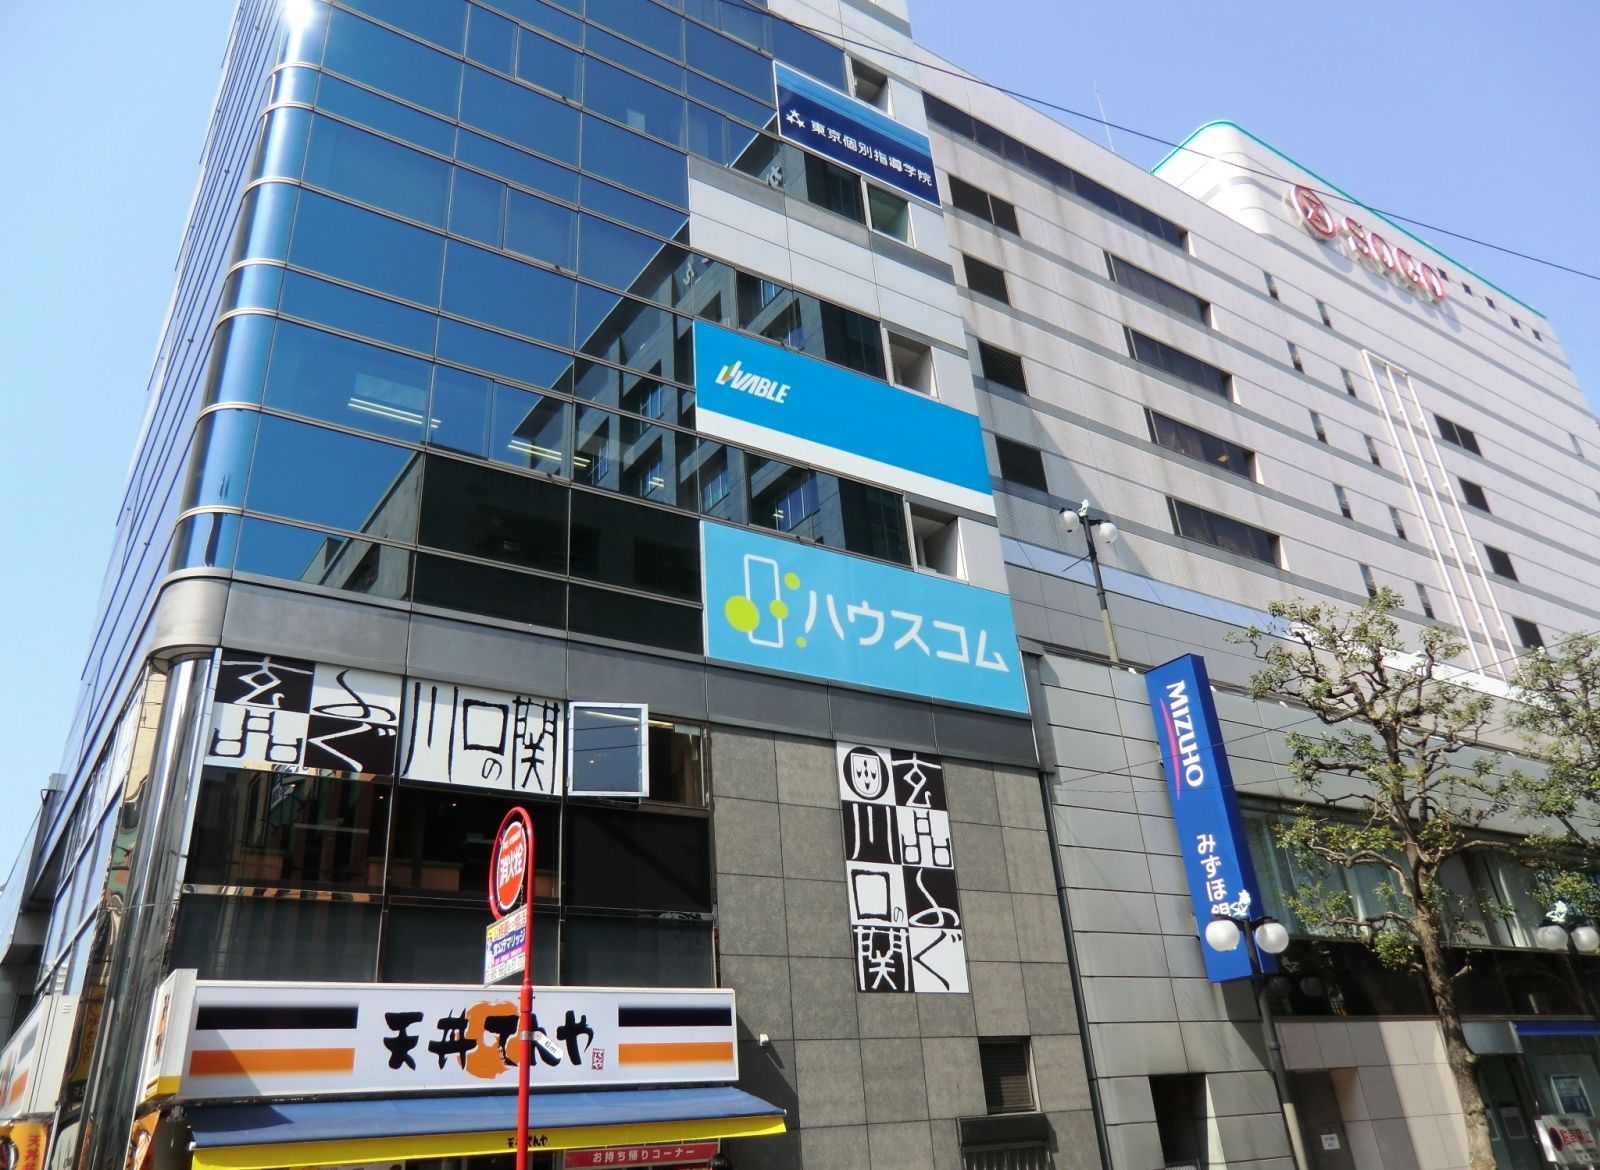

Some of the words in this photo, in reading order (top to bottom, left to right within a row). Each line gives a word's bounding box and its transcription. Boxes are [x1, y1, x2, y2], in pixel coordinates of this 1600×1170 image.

[810, 120, 933, 187] 東京個別指導学院
[1341, 217, 1446, 299] SOGO
[715, 360, 791, 404] LIVABLE
[804, 590, 1010, 673] ハウスコム
[1166, 679, 1204, 788] MIZUHO
[499, 842, 524, 888] 消火栓
[592, 1147, 695, 1163] お持ち帰りコーナー
